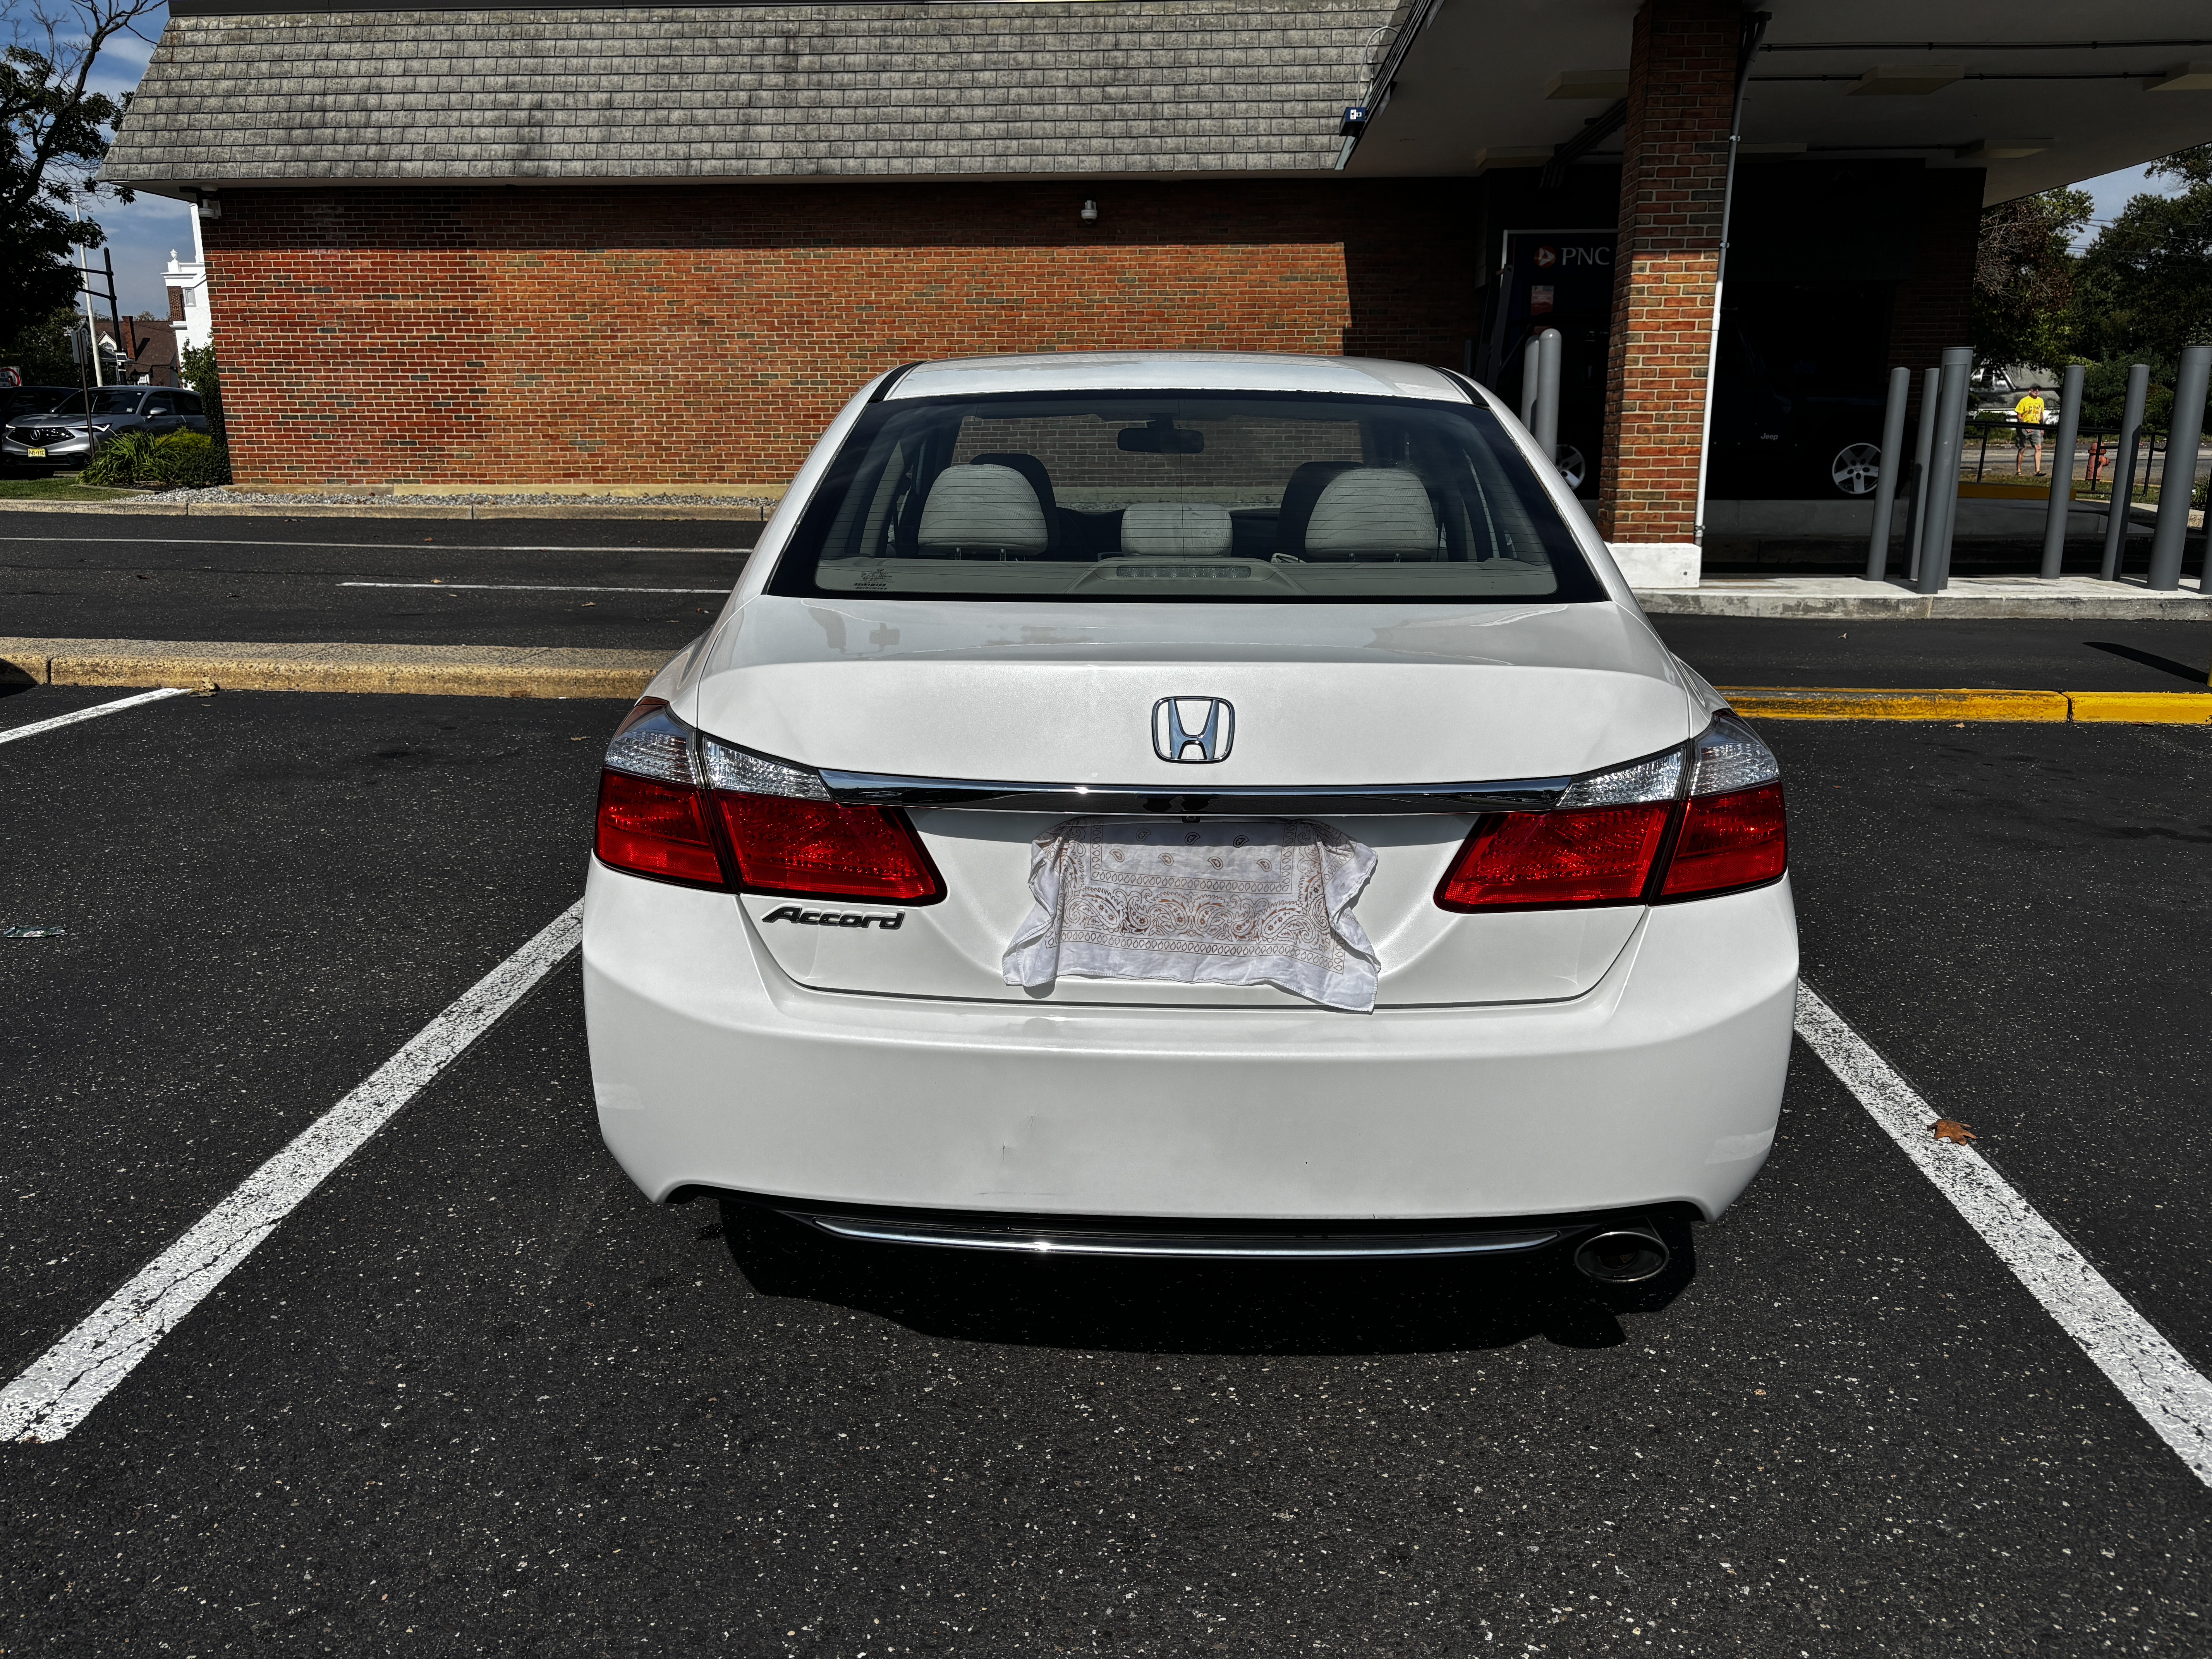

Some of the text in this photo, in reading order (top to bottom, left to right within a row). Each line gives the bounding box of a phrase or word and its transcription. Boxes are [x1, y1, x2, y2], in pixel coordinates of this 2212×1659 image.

[1560, 246, 1610, 266] PNC
[1760, 432, 1779, 441] Jeep
[761, 903, 905, 929] Accord
